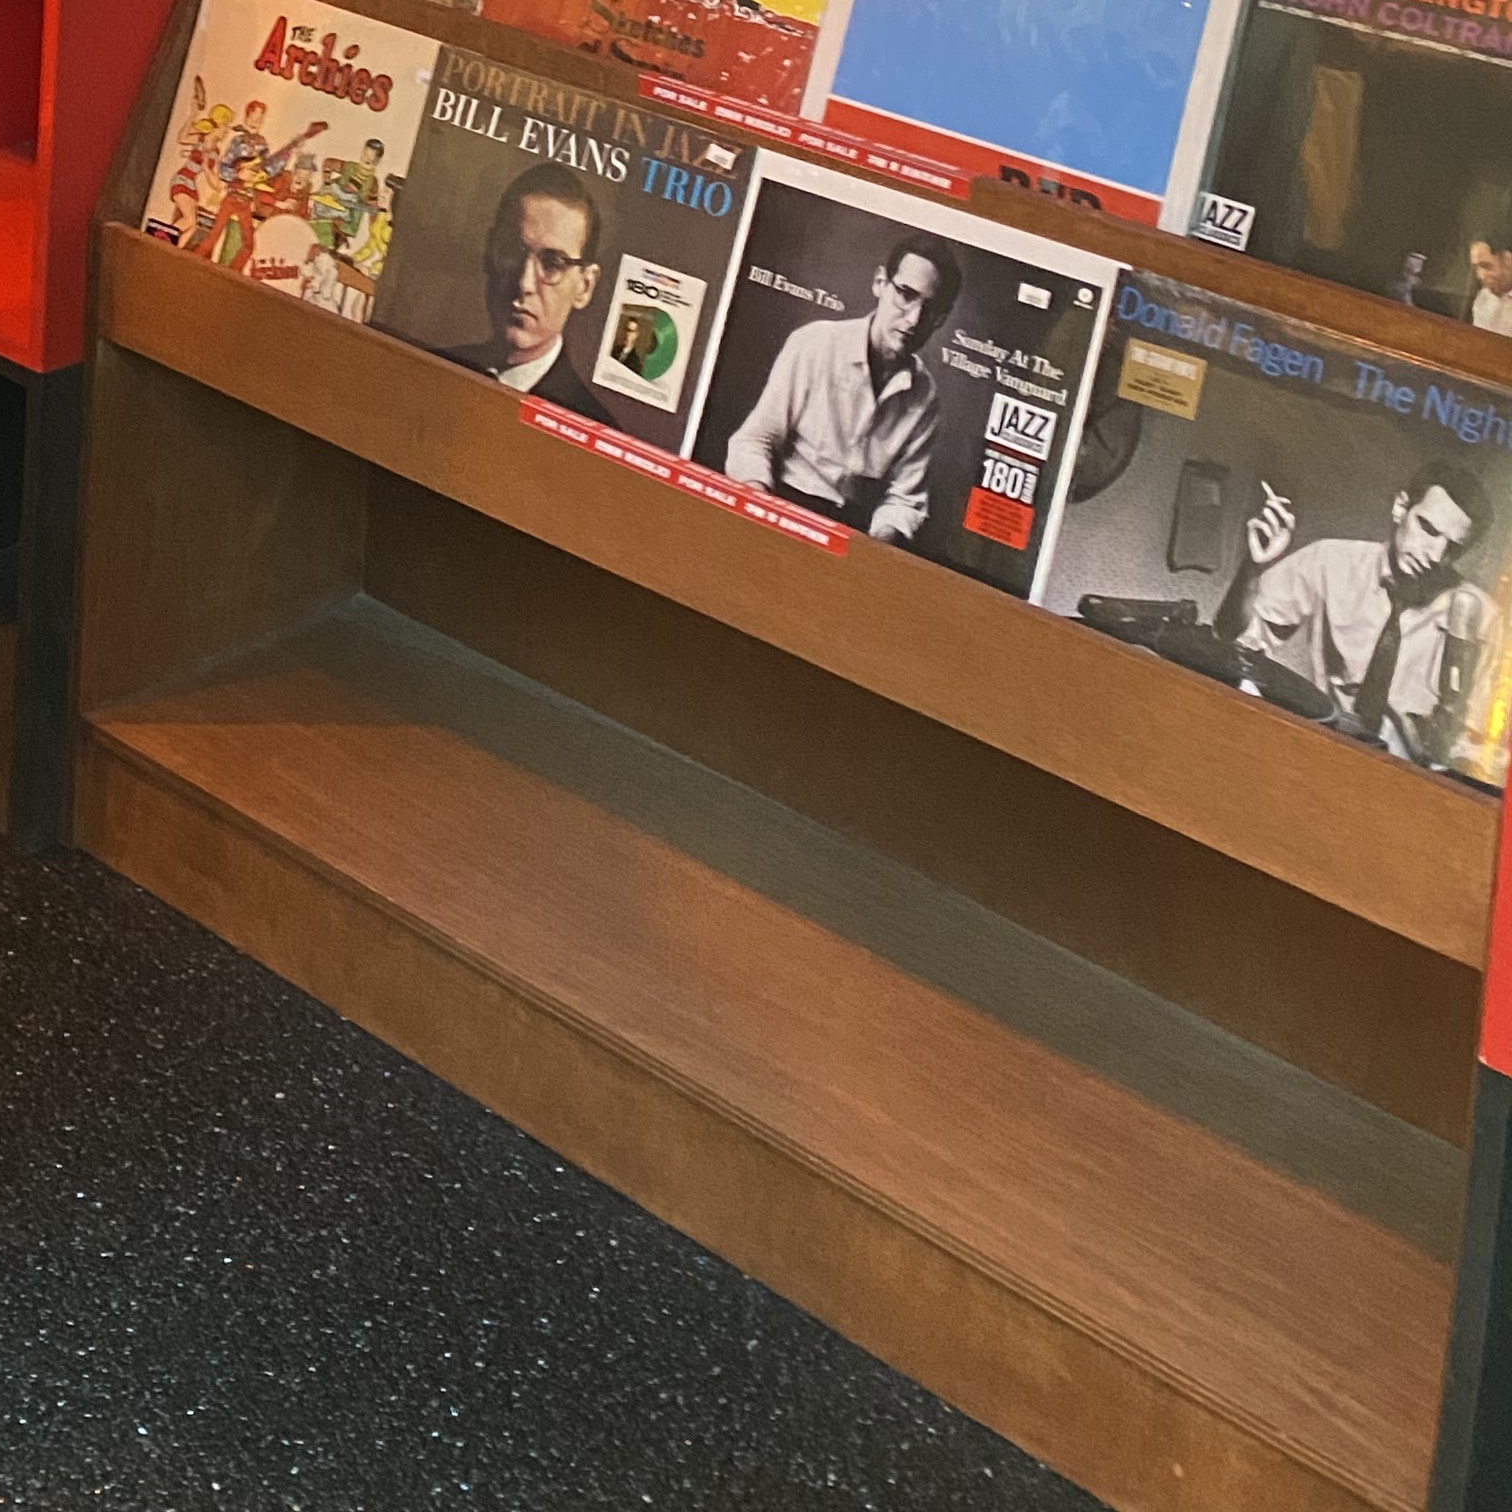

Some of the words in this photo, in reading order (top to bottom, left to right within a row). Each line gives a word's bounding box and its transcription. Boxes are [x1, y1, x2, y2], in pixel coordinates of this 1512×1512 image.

[291, 25, 318, 44] THE
[254, 15, 393, 112] Archies
[442, 53, 608, 132] PORTRAIT
[610, 108, 651, 149] IN
[432, 88, 510, 144] BILL
[519, 117, 631, 184] EVANS
[641, 157, 734, 218] TRIO
[748, 265, 774, 287] Bill
[813, 288, 846, 312] Trio
[941, 347, 992, 379] Village
[952, 329, 1011, 363] Sunday
[1008, 349, 1029, 369] At
[1031, 355, 1065, 381] The
[1118, 286, 1228, 350] Donald
[1228, 322, 1324, 384] Fagen
[1355, 360, 1416, 414] The
[991, 402, 1050, 443] JAZZ
[982, 459, 1026, 500] 180
